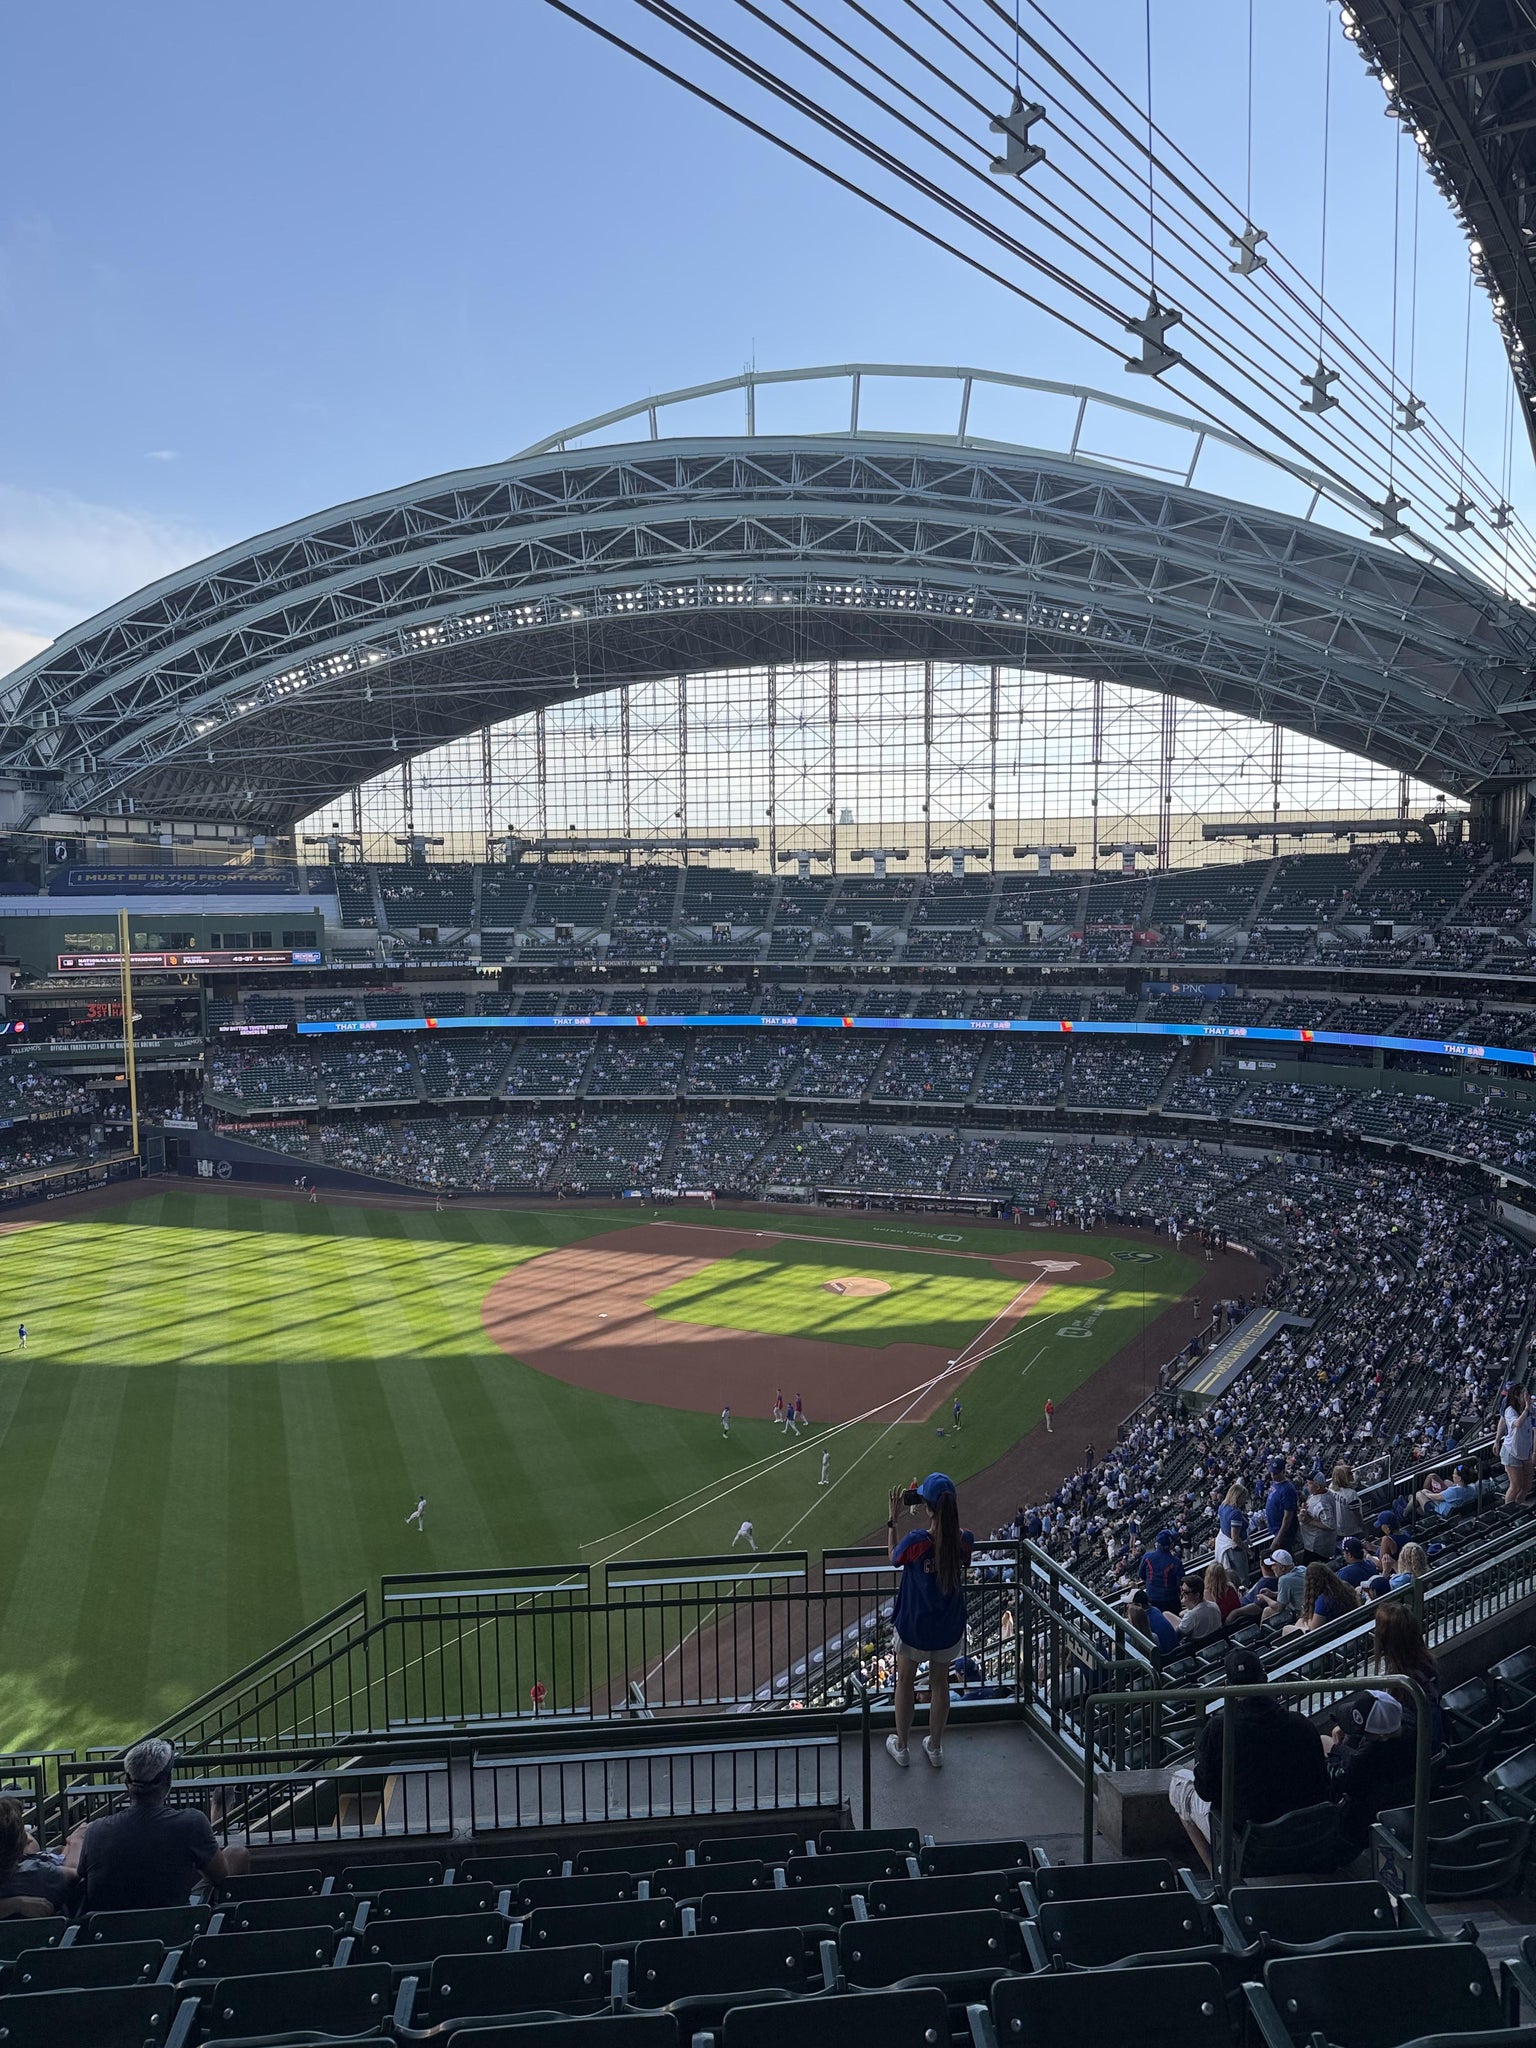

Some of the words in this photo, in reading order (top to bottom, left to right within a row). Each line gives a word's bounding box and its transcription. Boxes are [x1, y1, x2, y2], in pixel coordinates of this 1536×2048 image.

[1182, 984, 1205, 993] PNC
[1203, 1027, 1226, 1035] THAT
[1444, 1044, 1466, 1054] THAT
[40, 1110, 60, 1120] NICOLET
[61, 1108, 72, 1117] LAW
